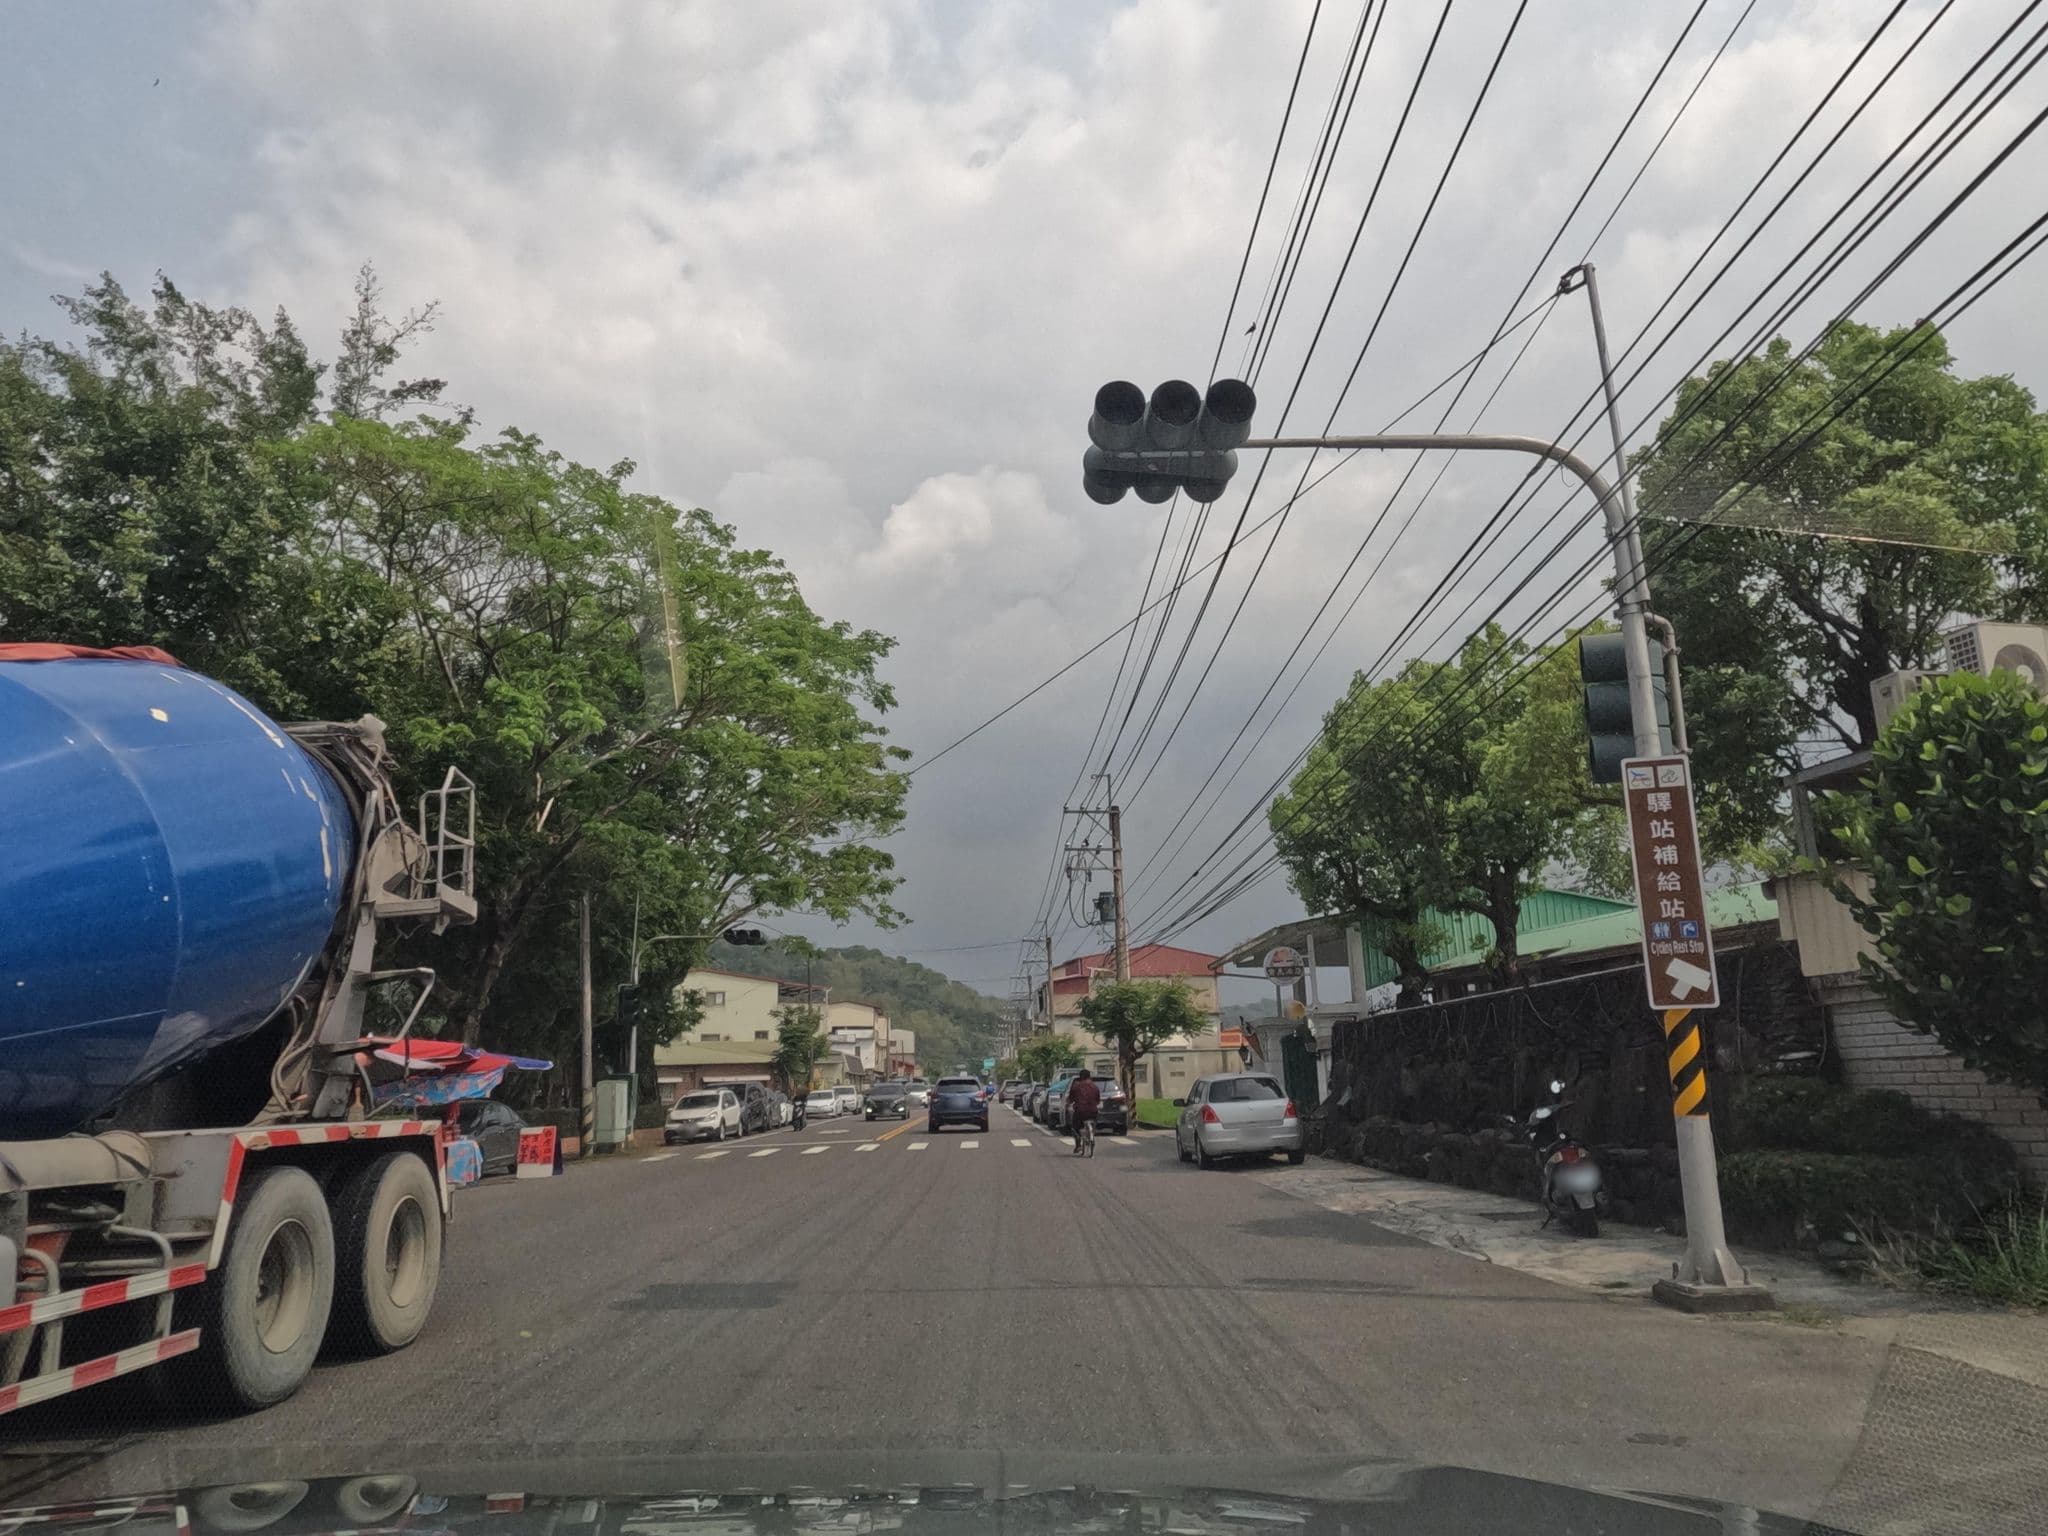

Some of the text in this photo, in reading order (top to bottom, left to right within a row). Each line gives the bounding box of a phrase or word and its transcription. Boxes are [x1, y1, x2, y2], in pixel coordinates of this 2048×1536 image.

[1647, 792, 1685, 919] 驛站補給站
[1651, 940, 1704, 956] Cycling Rest Stop
